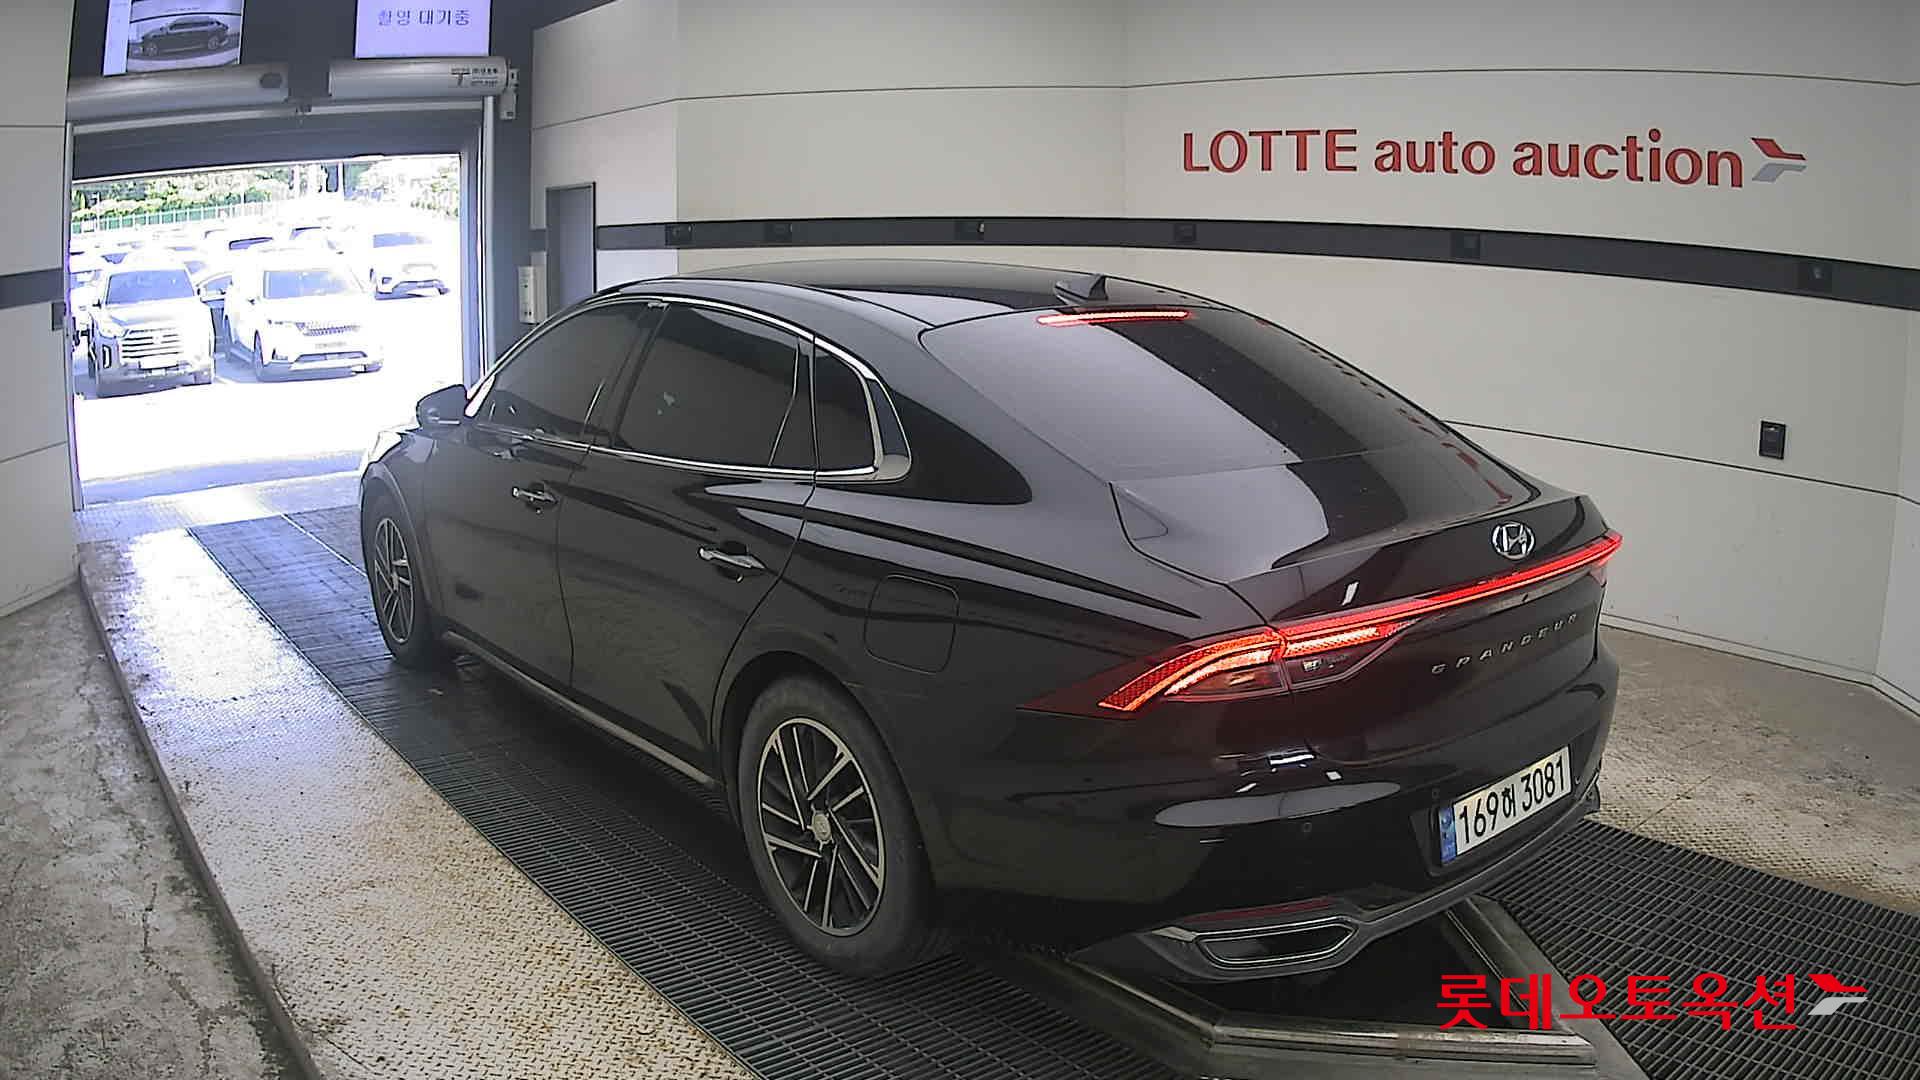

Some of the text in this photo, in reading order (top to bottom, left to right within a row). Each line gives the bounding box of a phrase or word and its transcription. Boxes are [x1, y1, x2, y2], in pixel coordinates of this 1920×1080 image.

[419, 9, 470, 26] 대기중
[1183, 128, 1743, 188] LOTTE auto auction
[1431, 613, 1577, 674] GRANDEUR
[1520, 755, 1565, 812] 3081
